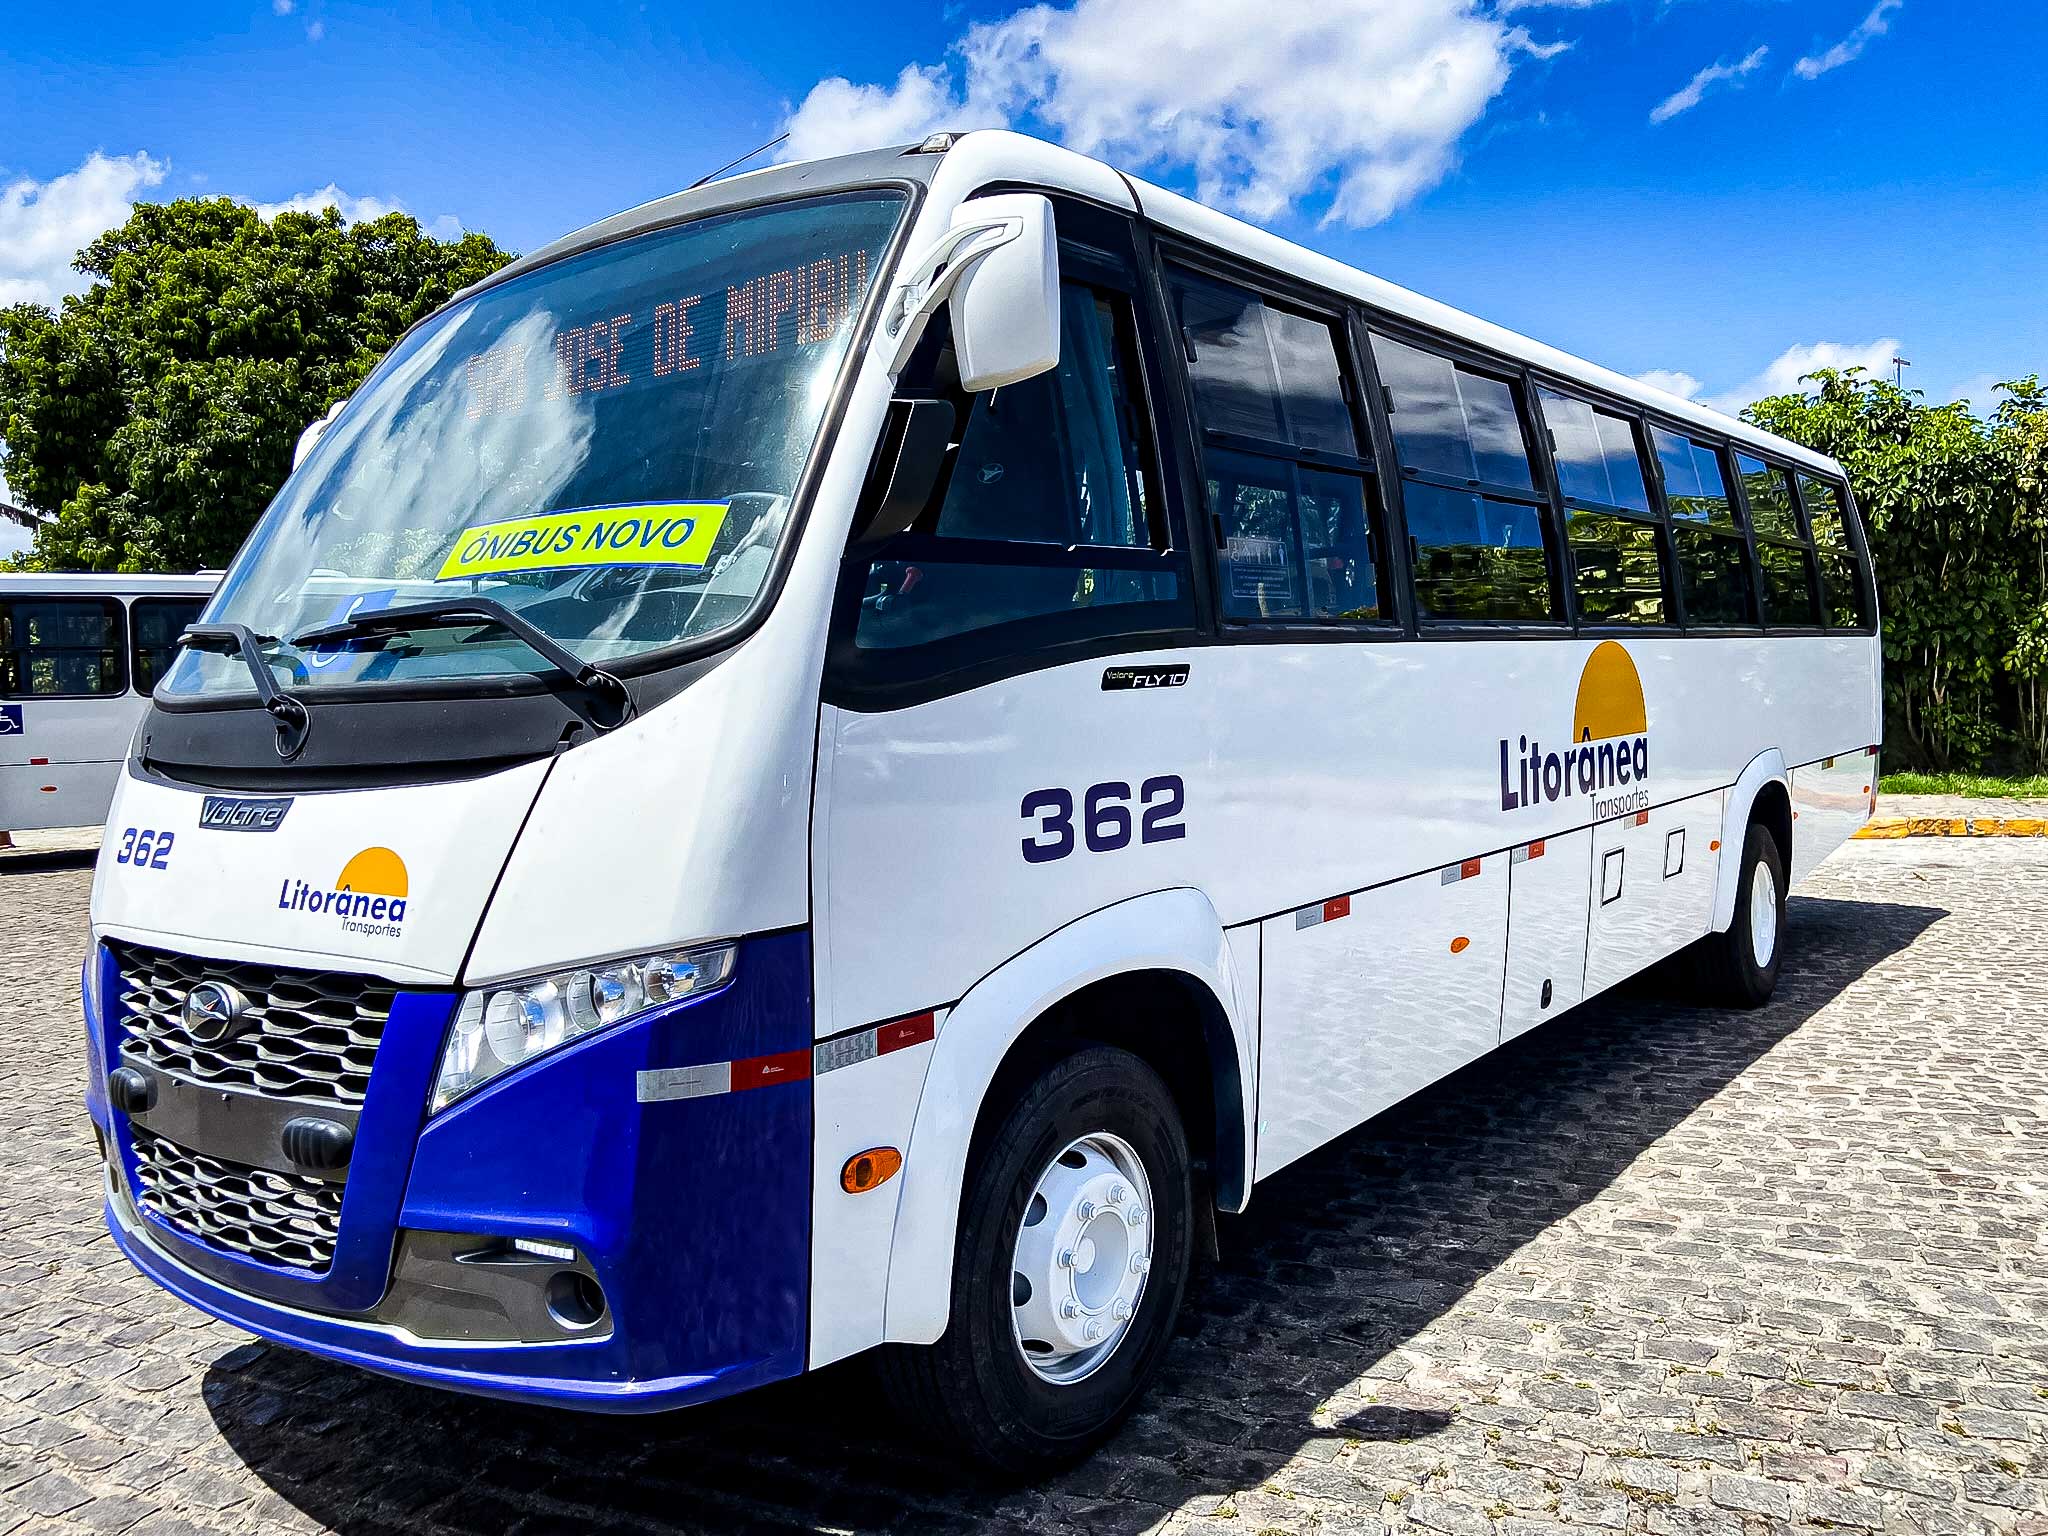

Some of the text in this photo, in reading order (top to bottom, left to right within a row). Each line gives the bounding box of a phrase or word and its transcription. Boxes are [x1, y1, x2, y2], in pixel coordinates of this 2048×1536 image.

[652, 294, 701, 378] DE
[460, 518, 695, 565] ÔNIBUS NOVO
[1132, 673, 1187, 688] FLY 10
[1499, 726, 1648, 812] Litorânea
[201, 801, 284, 826] Volare
[1021, 775, 1186, 863] 362
[1590, 787, 1649, 822] Transportes
[116, 827, 175, 870] 362
[278, 878, 408, 922] Litorânea
[342, 917, 402, 938] Transportes
